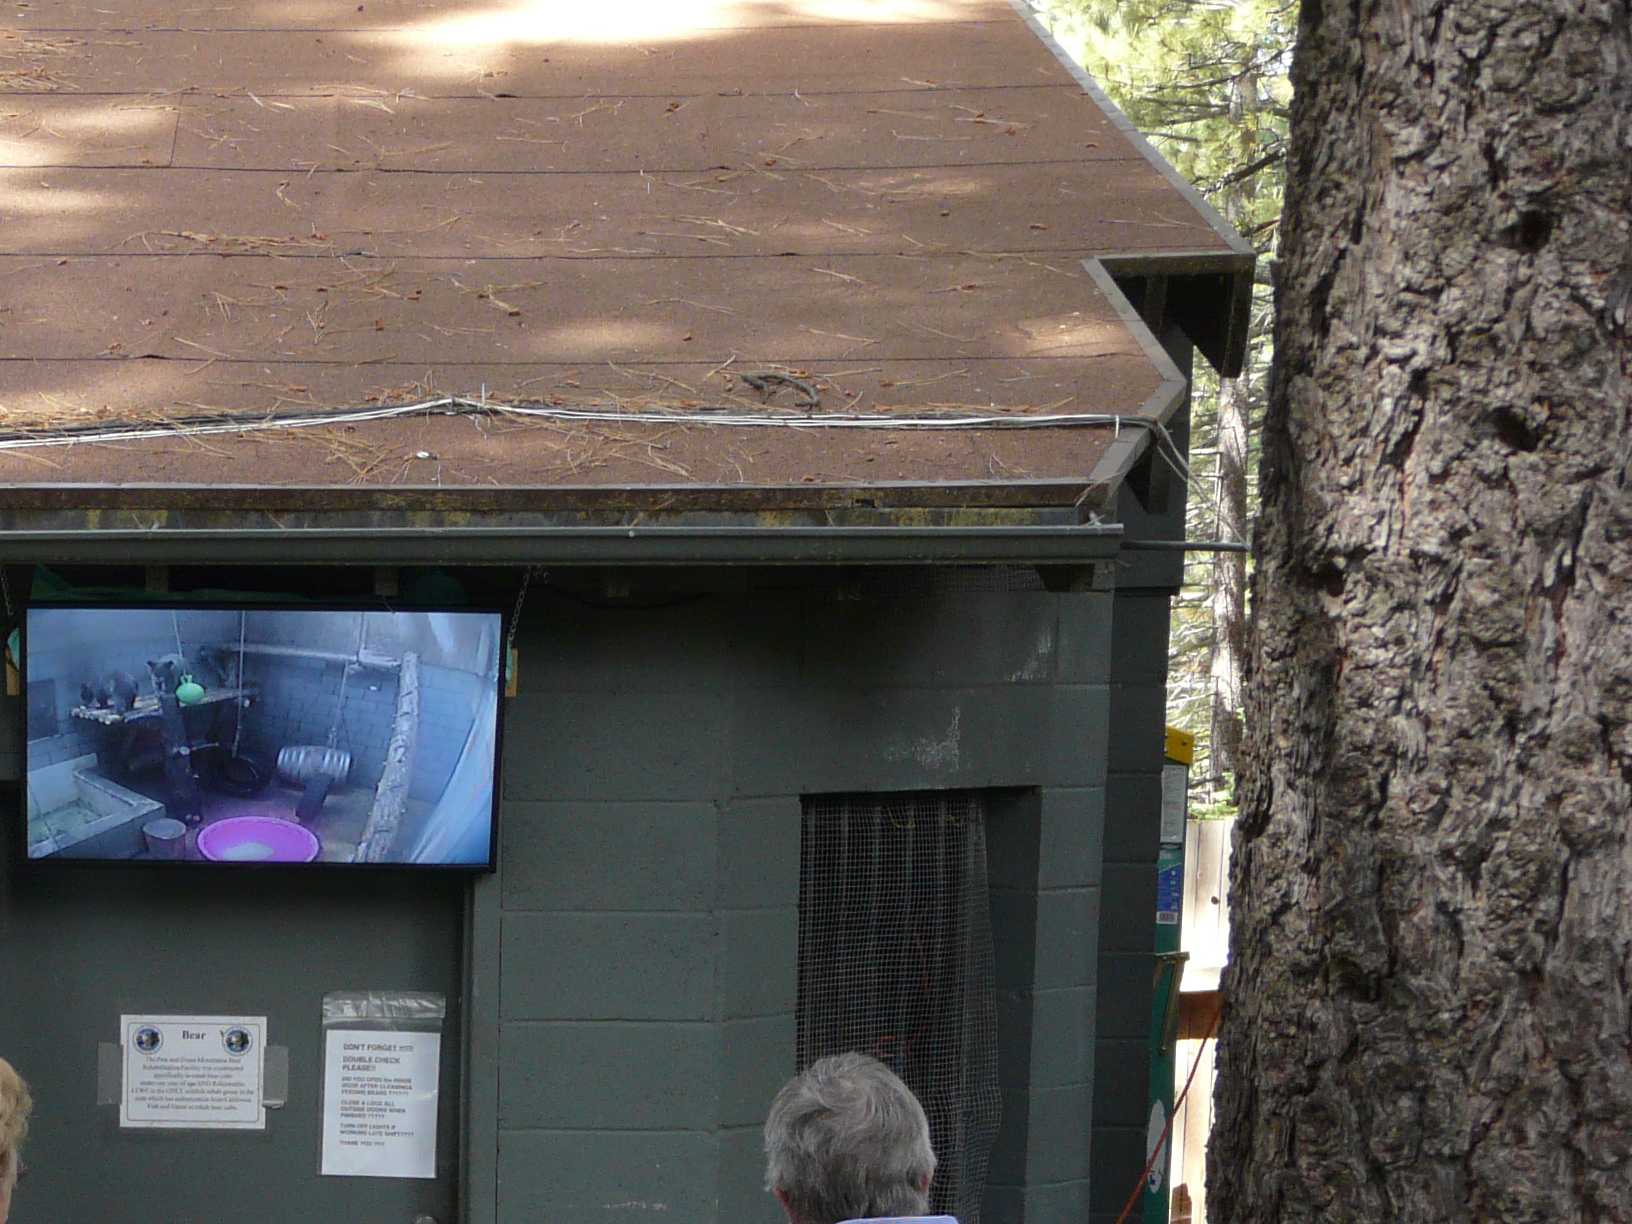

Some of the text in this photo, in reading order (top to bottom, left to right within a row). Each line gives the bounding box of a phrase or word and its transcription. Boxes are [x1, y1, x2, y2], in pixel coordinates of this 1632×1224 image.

[182, 1030, 207, 1040] Bear
[343, 1043, 365, 1051] DON'T
[367, 1044, 396, 1052] FORGET
[342, 1055, 401, 1064] DOUBLE CHECK
